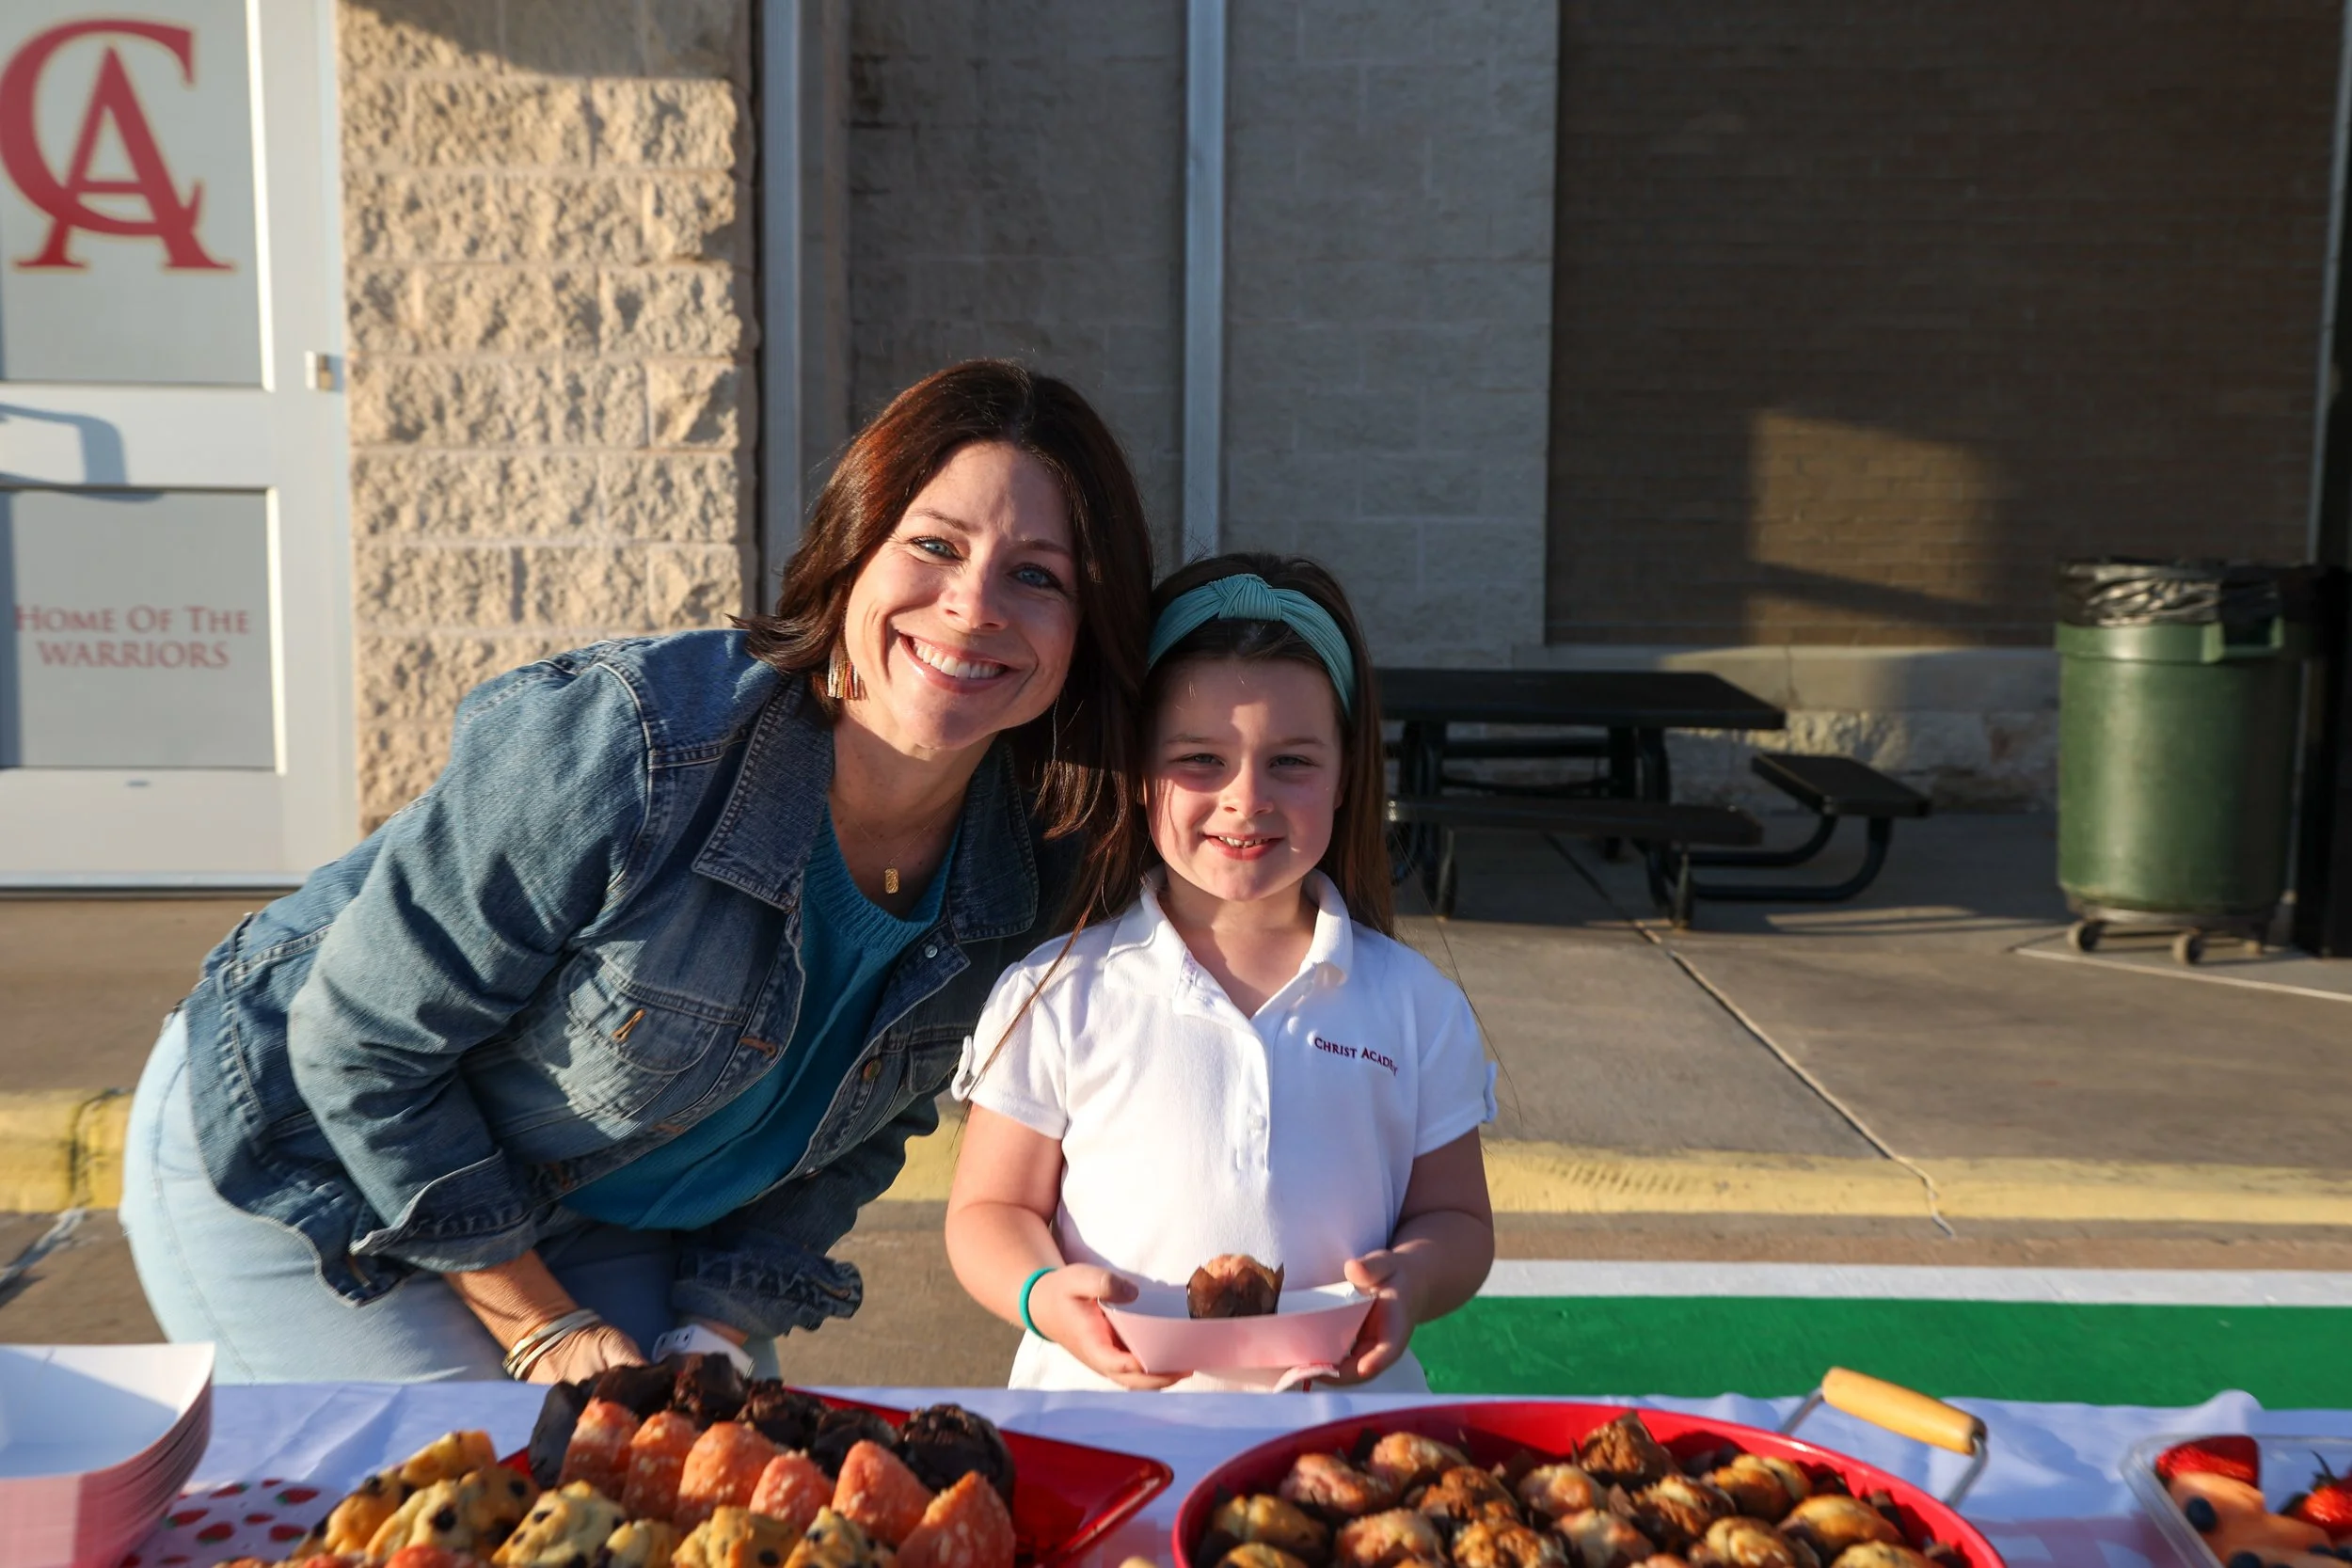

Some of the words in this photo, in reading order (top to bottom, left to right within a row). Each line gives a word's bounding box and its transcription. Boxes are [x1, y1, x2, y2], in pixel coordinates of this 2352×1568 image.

[13, 604, 117, 633] HOME
[126, 605, 173, 634] OF
[184, 605, 250, 634] THE
[36, 641, 230, 669] WARRIORS
[1314, 1037, 1357, 1058] CHRIST
[1360, 1047, 1398, 1076] ACADEY
